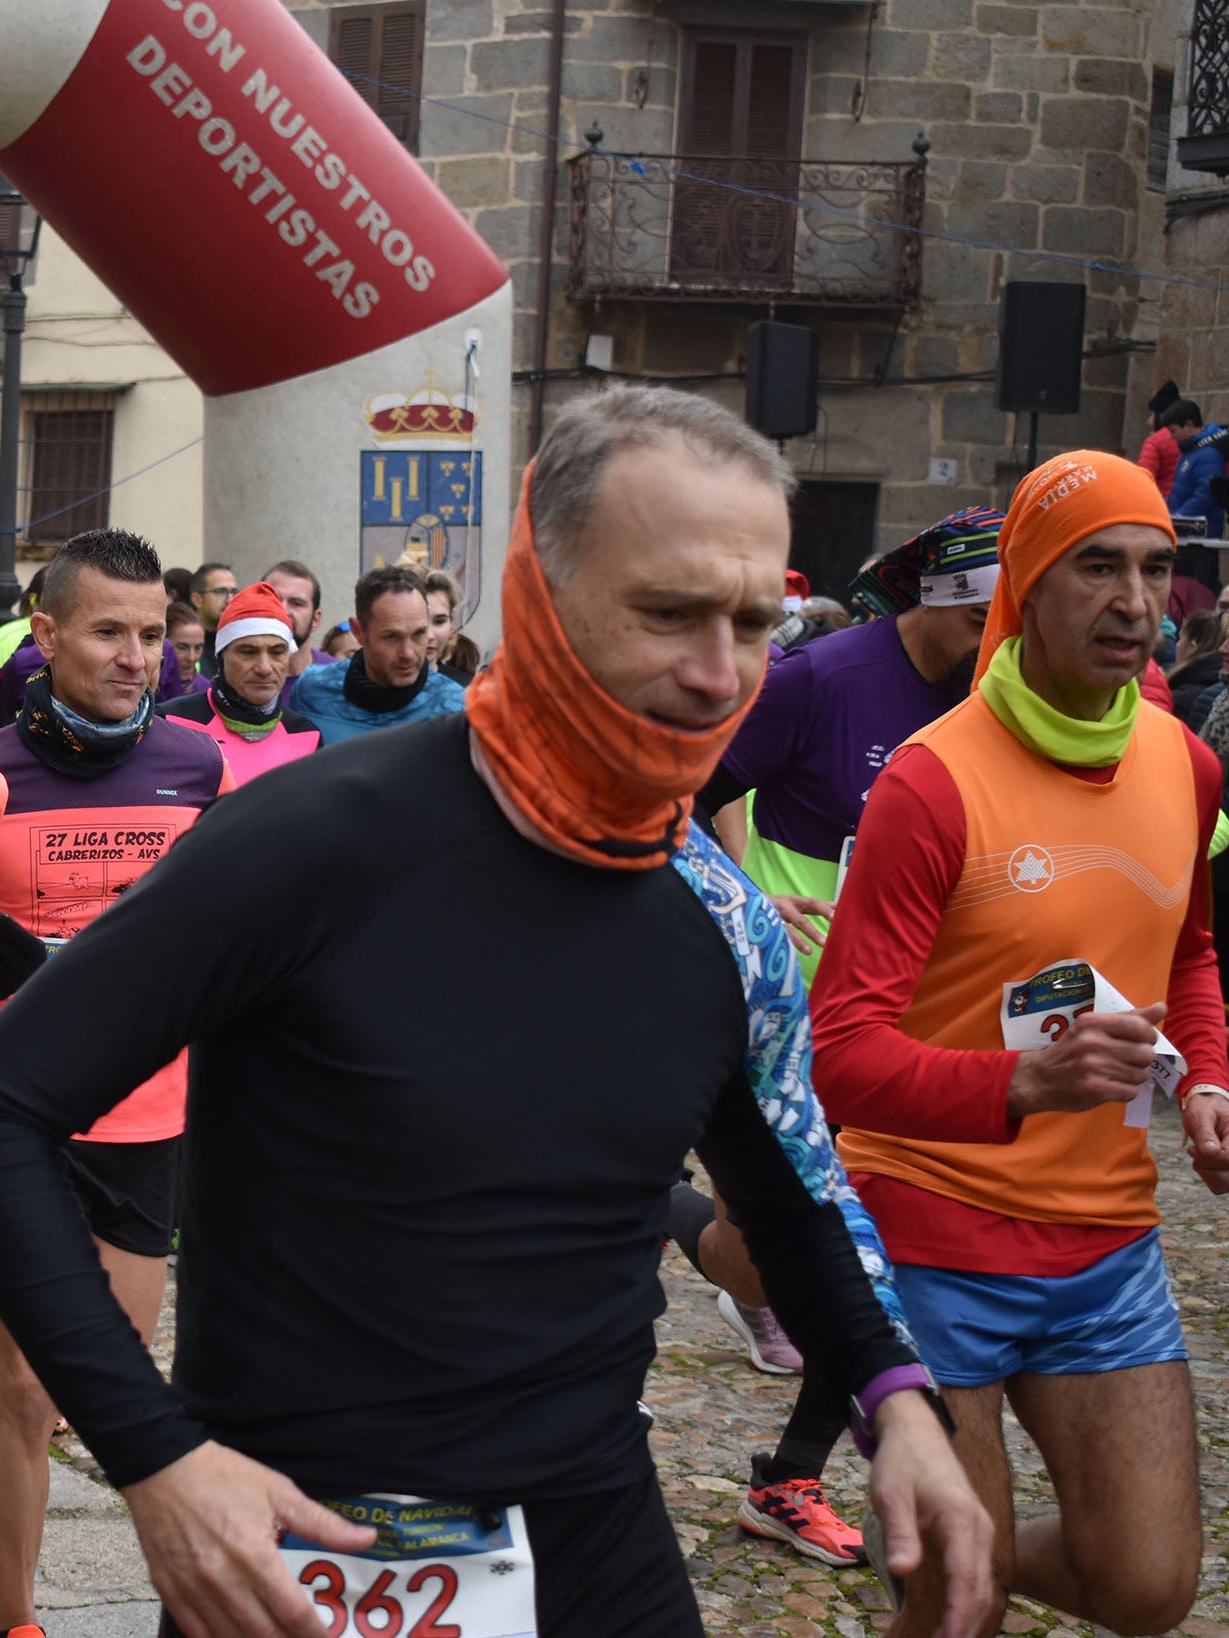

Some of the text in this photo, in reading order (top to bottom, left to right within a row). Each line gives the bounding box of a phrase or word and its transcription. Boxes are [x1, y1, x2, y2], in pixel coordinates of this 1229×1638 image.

[162, 0, 436, 292] ON NUESTROS
[125, 34, 380, 319] DEPORTISTAS
[1038, 470, 1098, 510] MEDIA
[45, 831, 166, 847] 27 LIGA CROSS
[48, 849, 124, 861] CABRERIZOS
[1030, 968, 1075, 986] TROFEO
[371, 1507, 395, 1526] DE
[299, 1559, 461, 1638] 362
